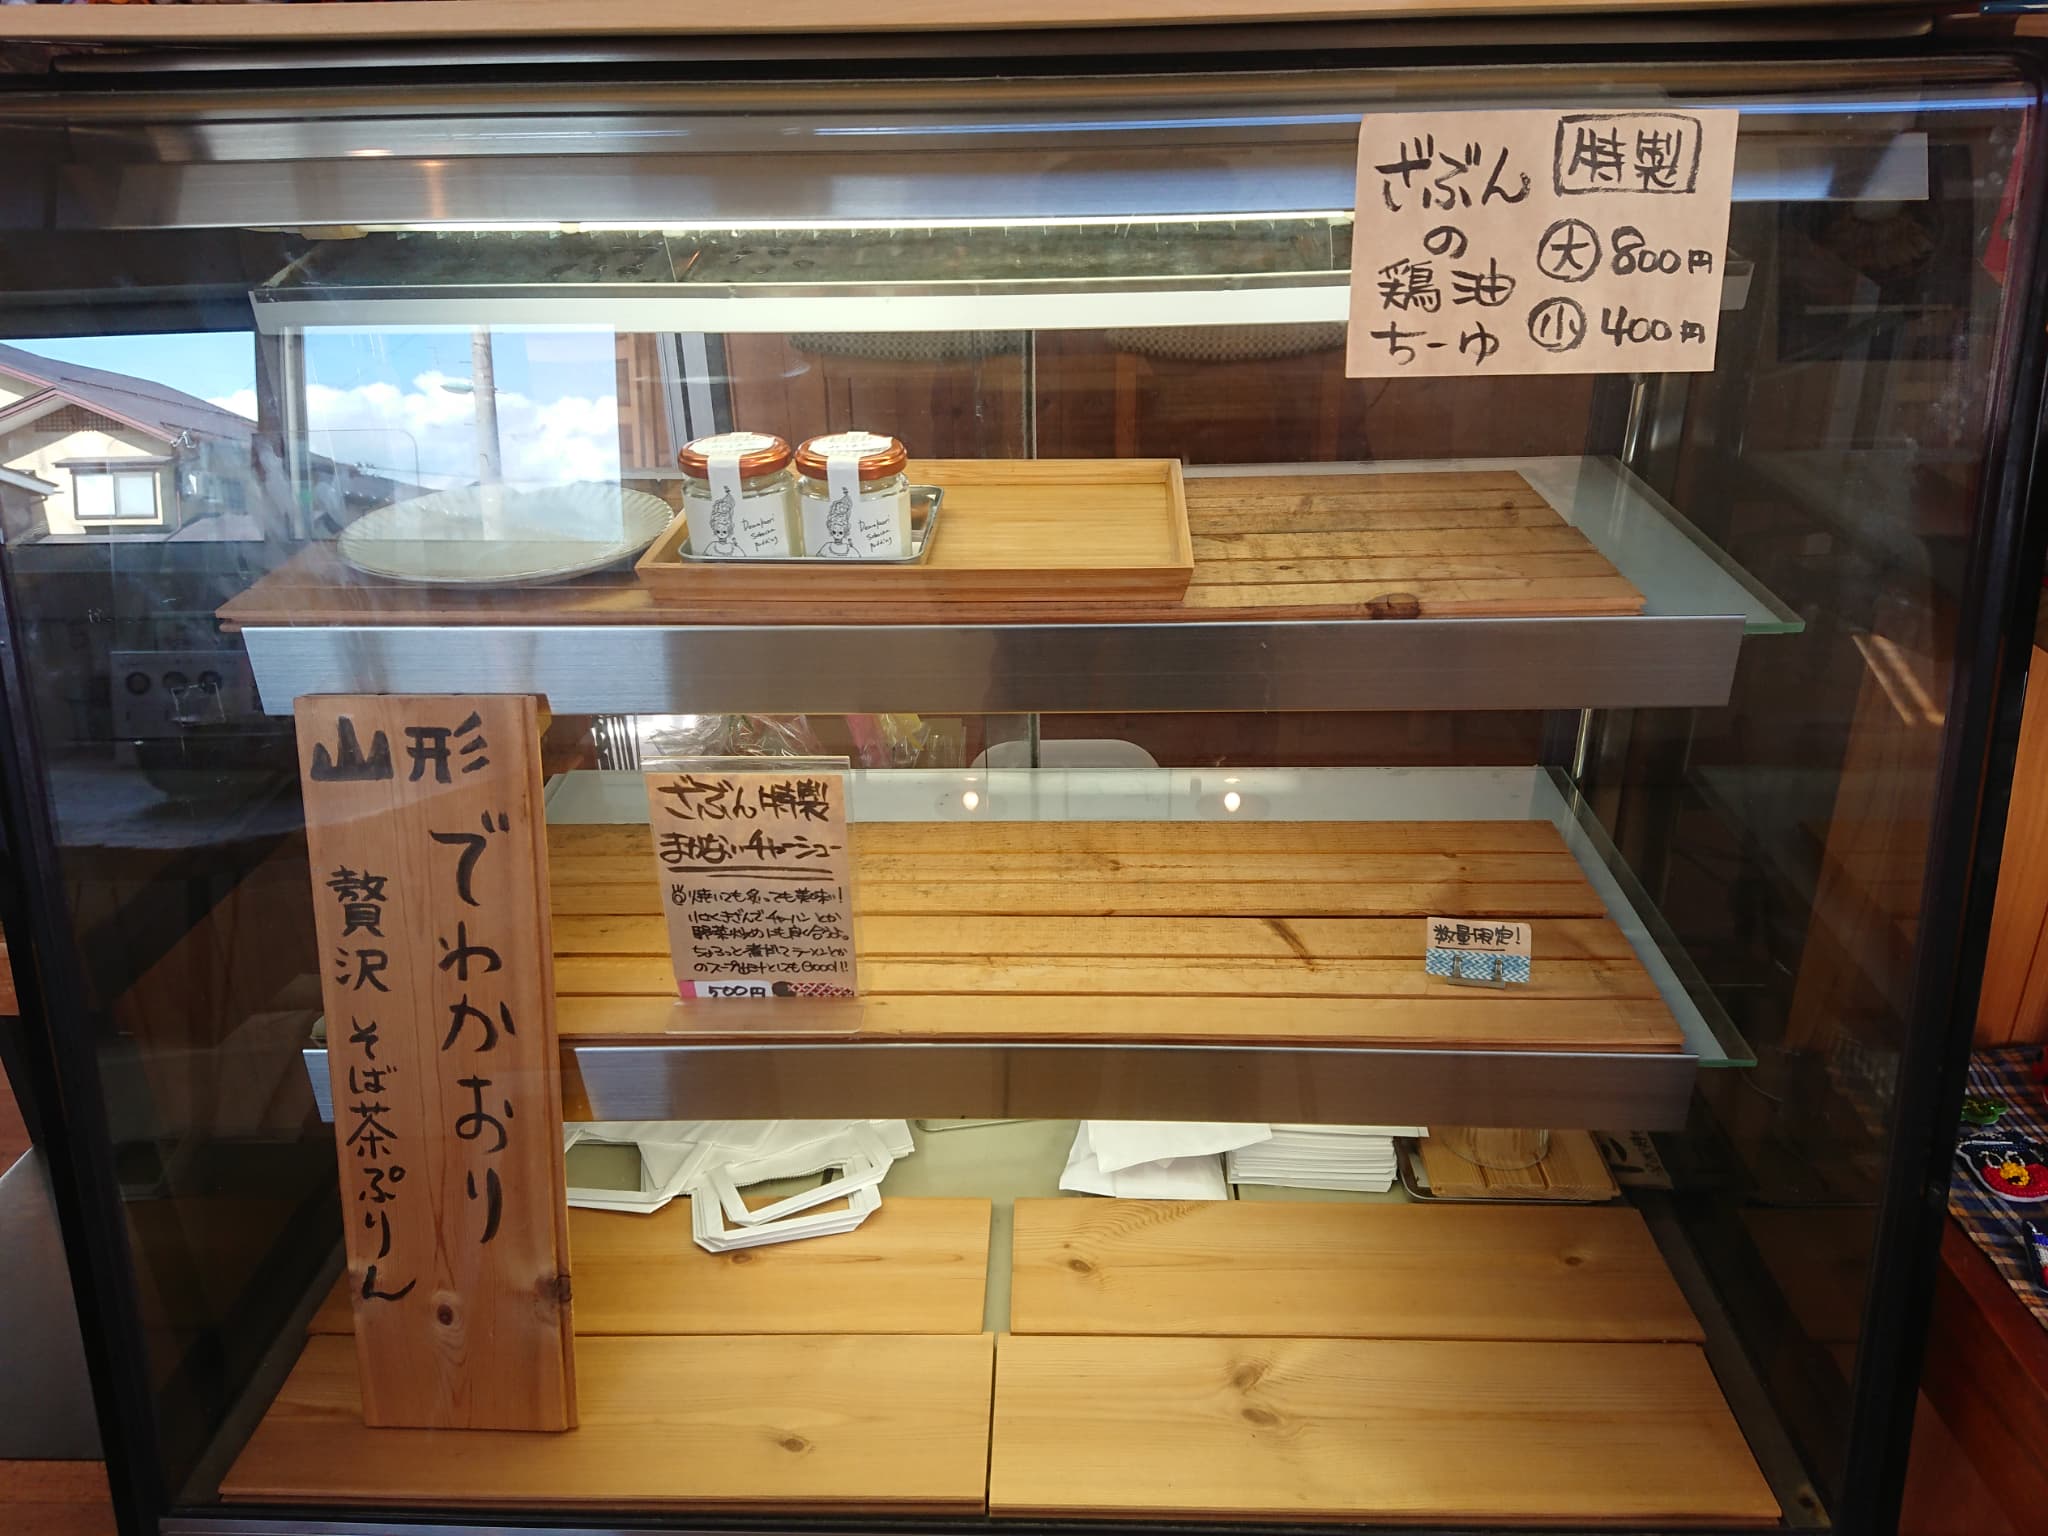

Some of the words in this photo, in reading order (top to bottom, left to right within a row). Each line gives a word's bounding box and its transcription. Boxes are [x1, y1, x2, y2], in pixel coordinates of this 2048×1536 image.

[1374, 133, 1531, 212] ざぶん
[1568, 126, 1684, 190] 特製
[1423, 225, 1468, 259] の
[1611, 226, 1713, 275] 800円
[1377, 257, 1516, 313] 鶏油
[1370, 320, 1500, 366] ちーゆ
[1601, 306, 1706, 347] 400円
[311, 711, 491, 784] 山形
[659, 829, 842, 864] まかないチャーシュー
[326, 865, 392, 992] 贅沢
[708, 986, 766, 998] 500円
[428, 810, 516, 1244] でわかおり
[346, 1015, 417, 1302] そば茶ぷりん
